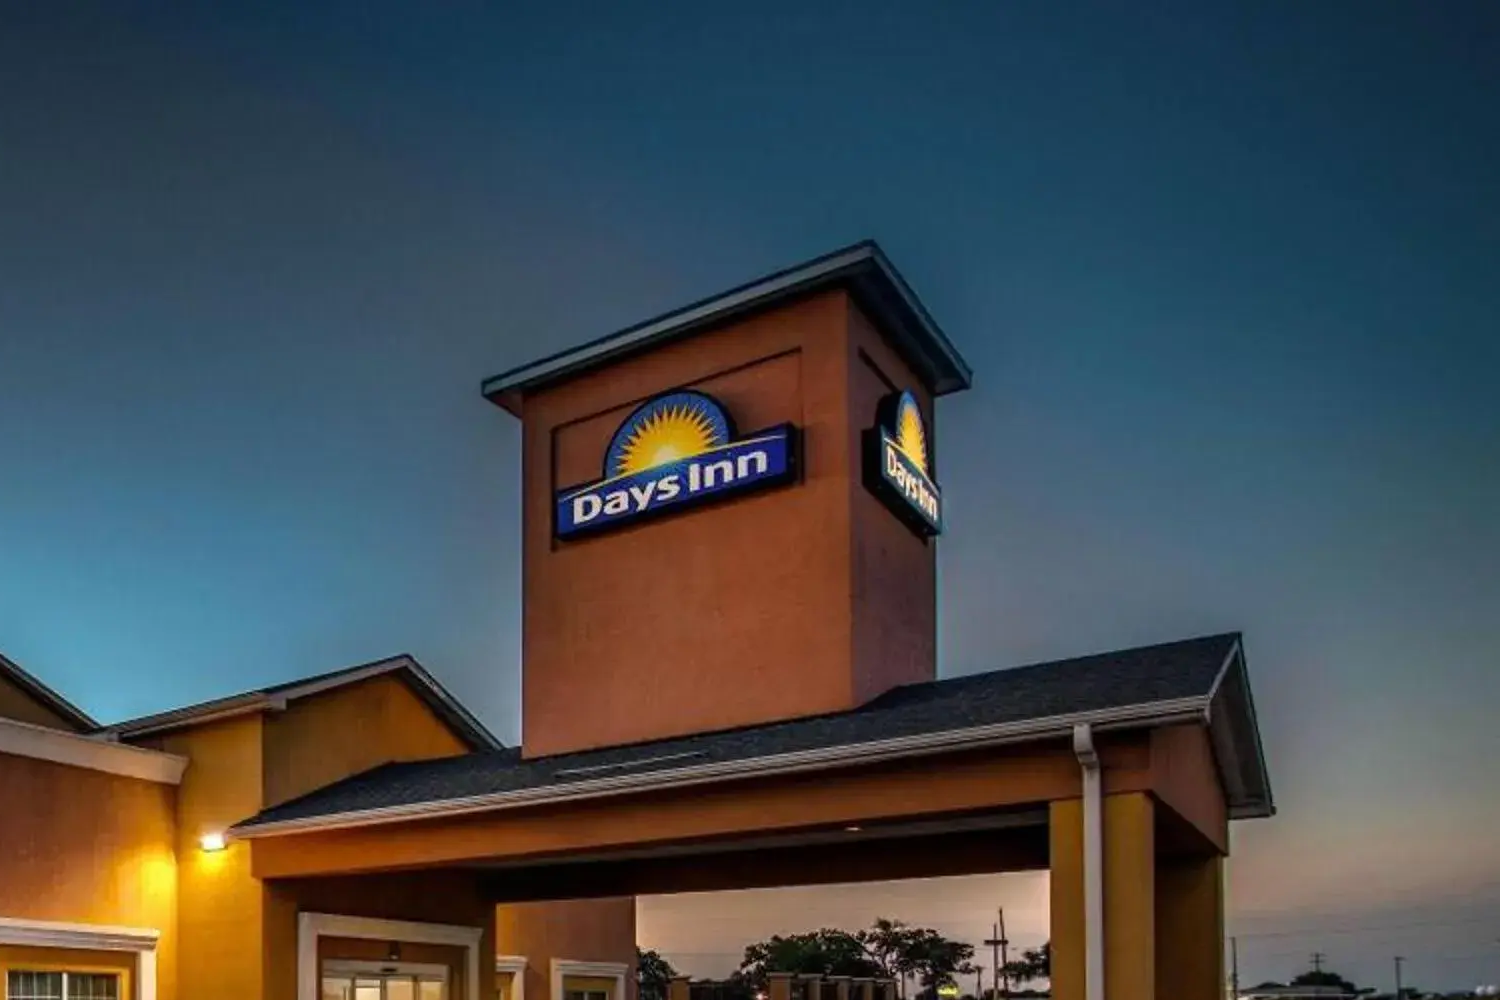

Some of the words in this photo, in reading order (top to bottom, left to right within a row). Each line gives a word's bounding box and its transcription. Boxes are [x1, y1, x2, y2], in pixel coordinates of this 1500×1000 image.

[572, 474, 681, 525] Days
[688, 450, 768, 492] Inn
[886, 445, 917, 501] Days
[918, 478, 938, 521] Inn
